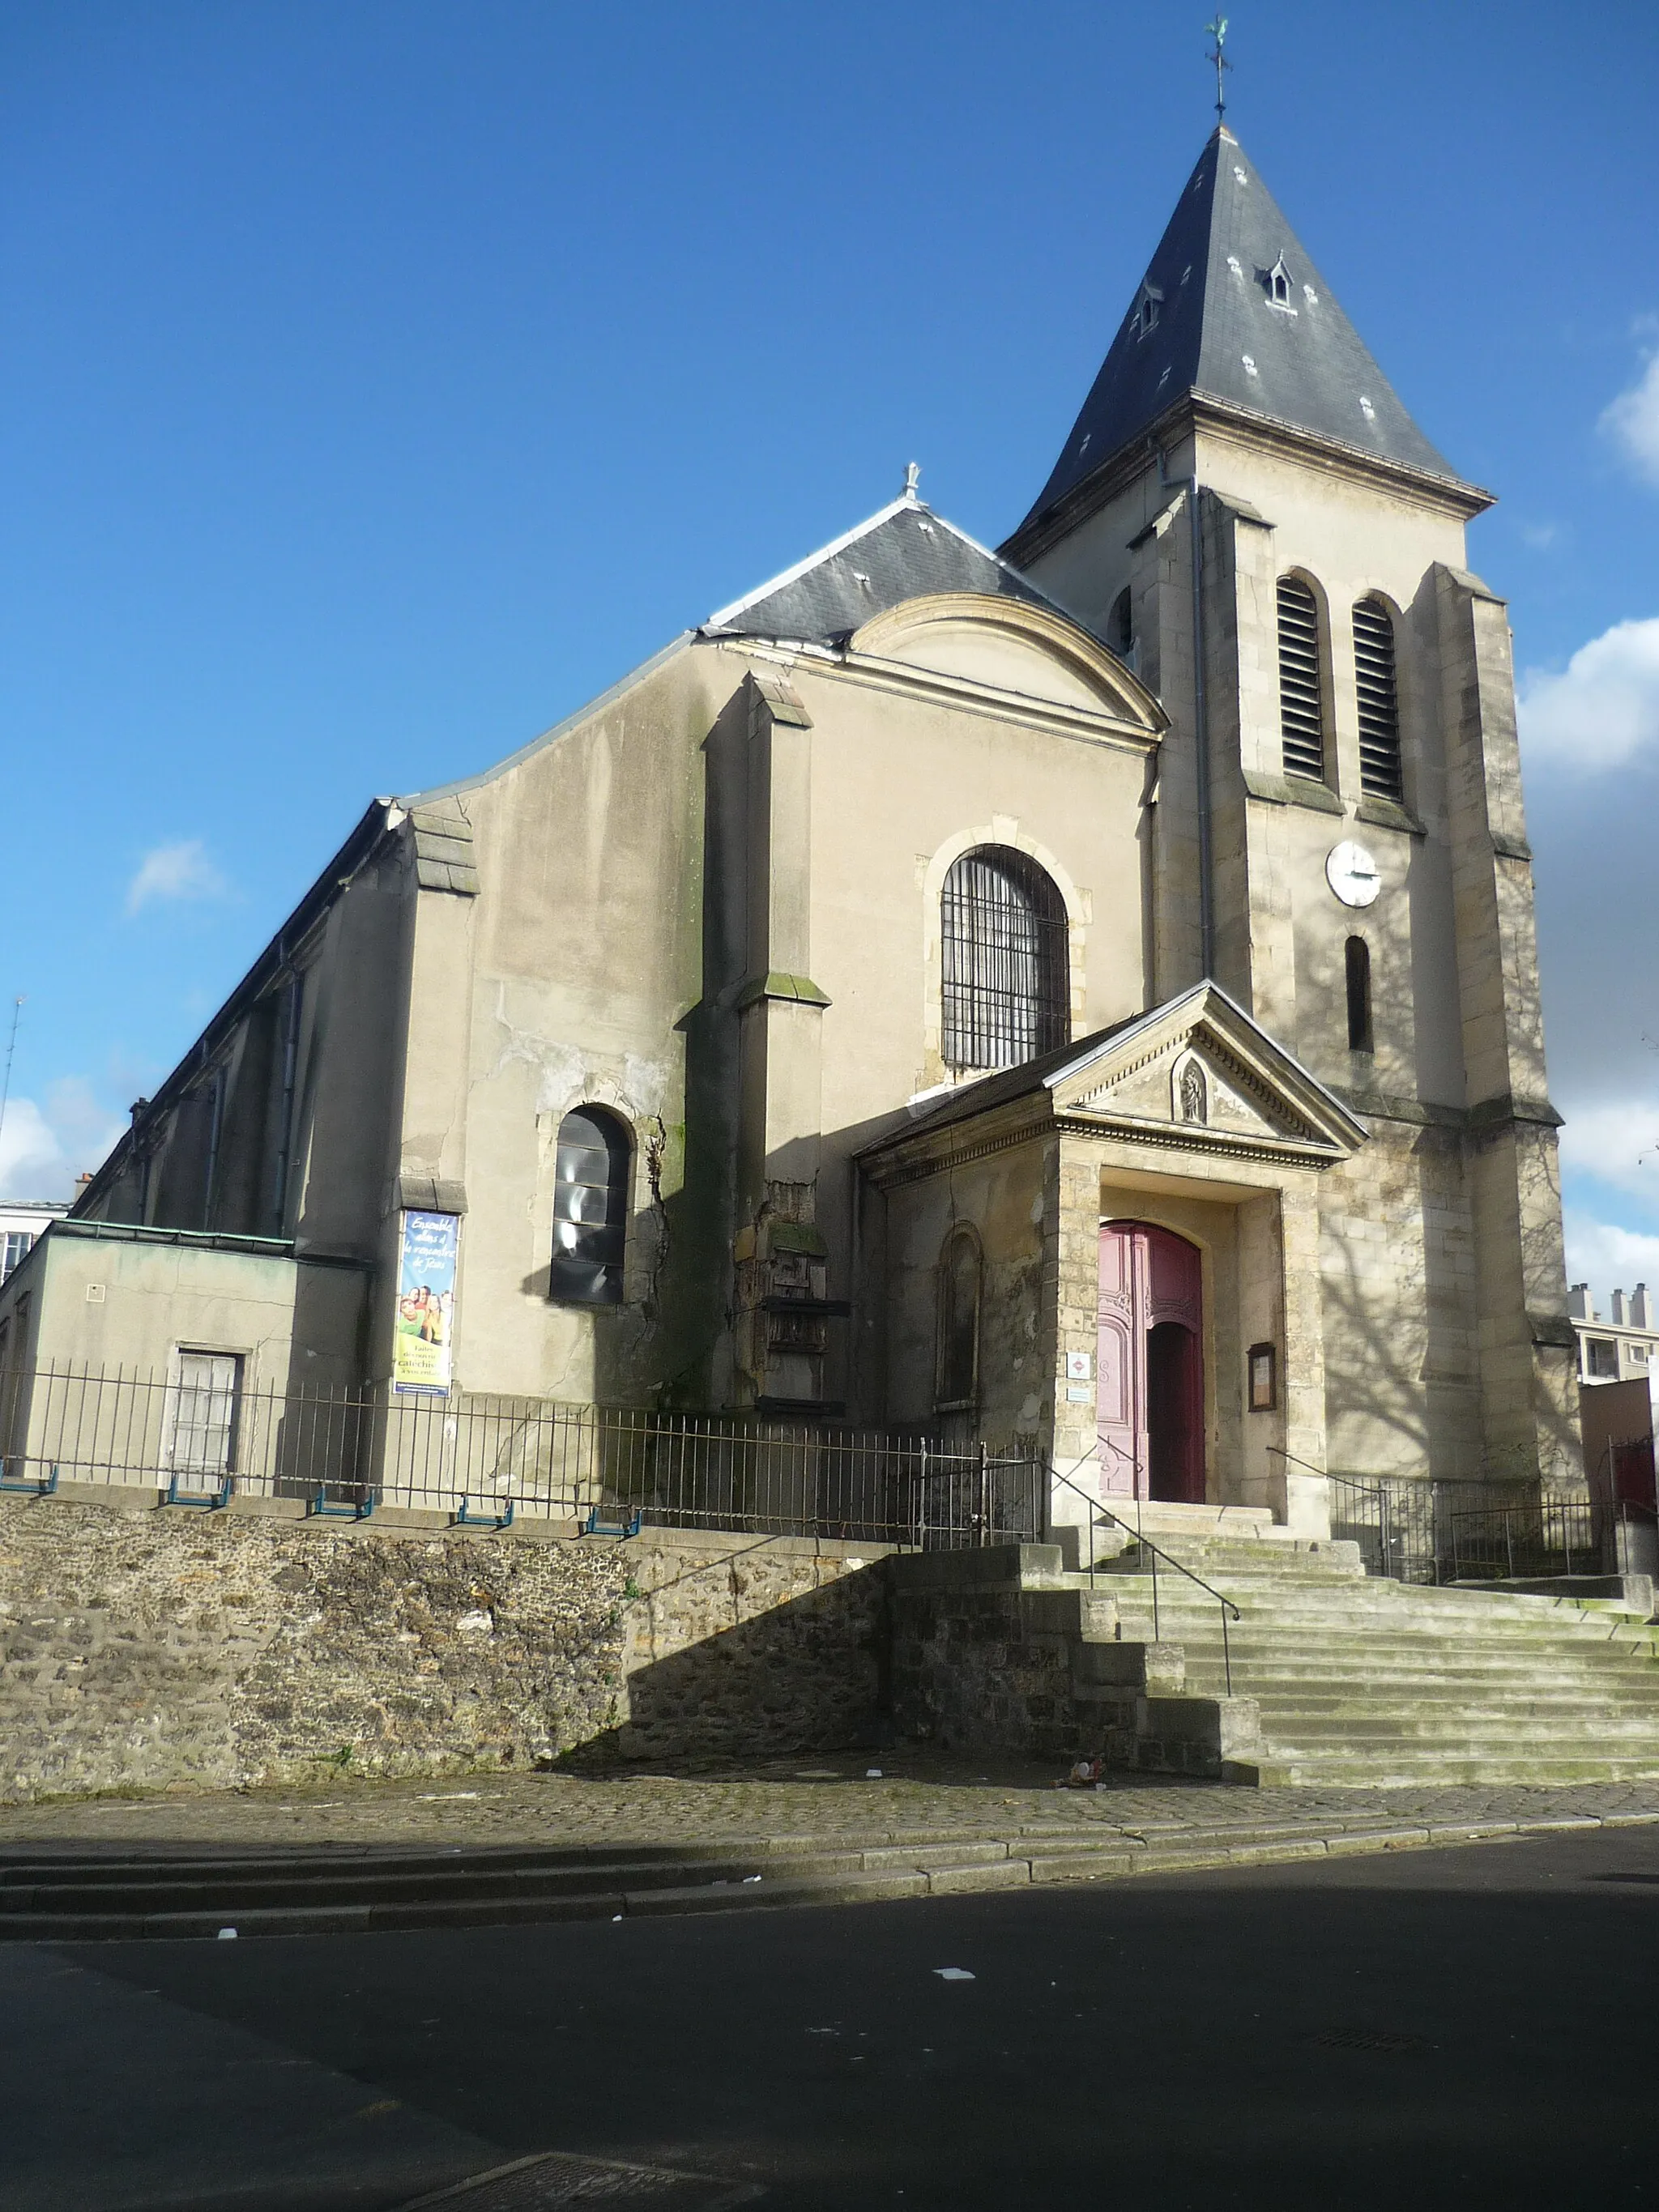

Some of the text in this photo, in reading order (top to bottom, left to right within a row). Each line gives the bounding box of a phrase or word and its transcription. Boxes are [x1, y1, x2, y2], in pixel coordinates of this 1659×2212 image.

[412, 1217, 453, 1231] Ensemble
[414, 1244, 455, 1257] rencontre
[413, 1256, 423, 1267] de
